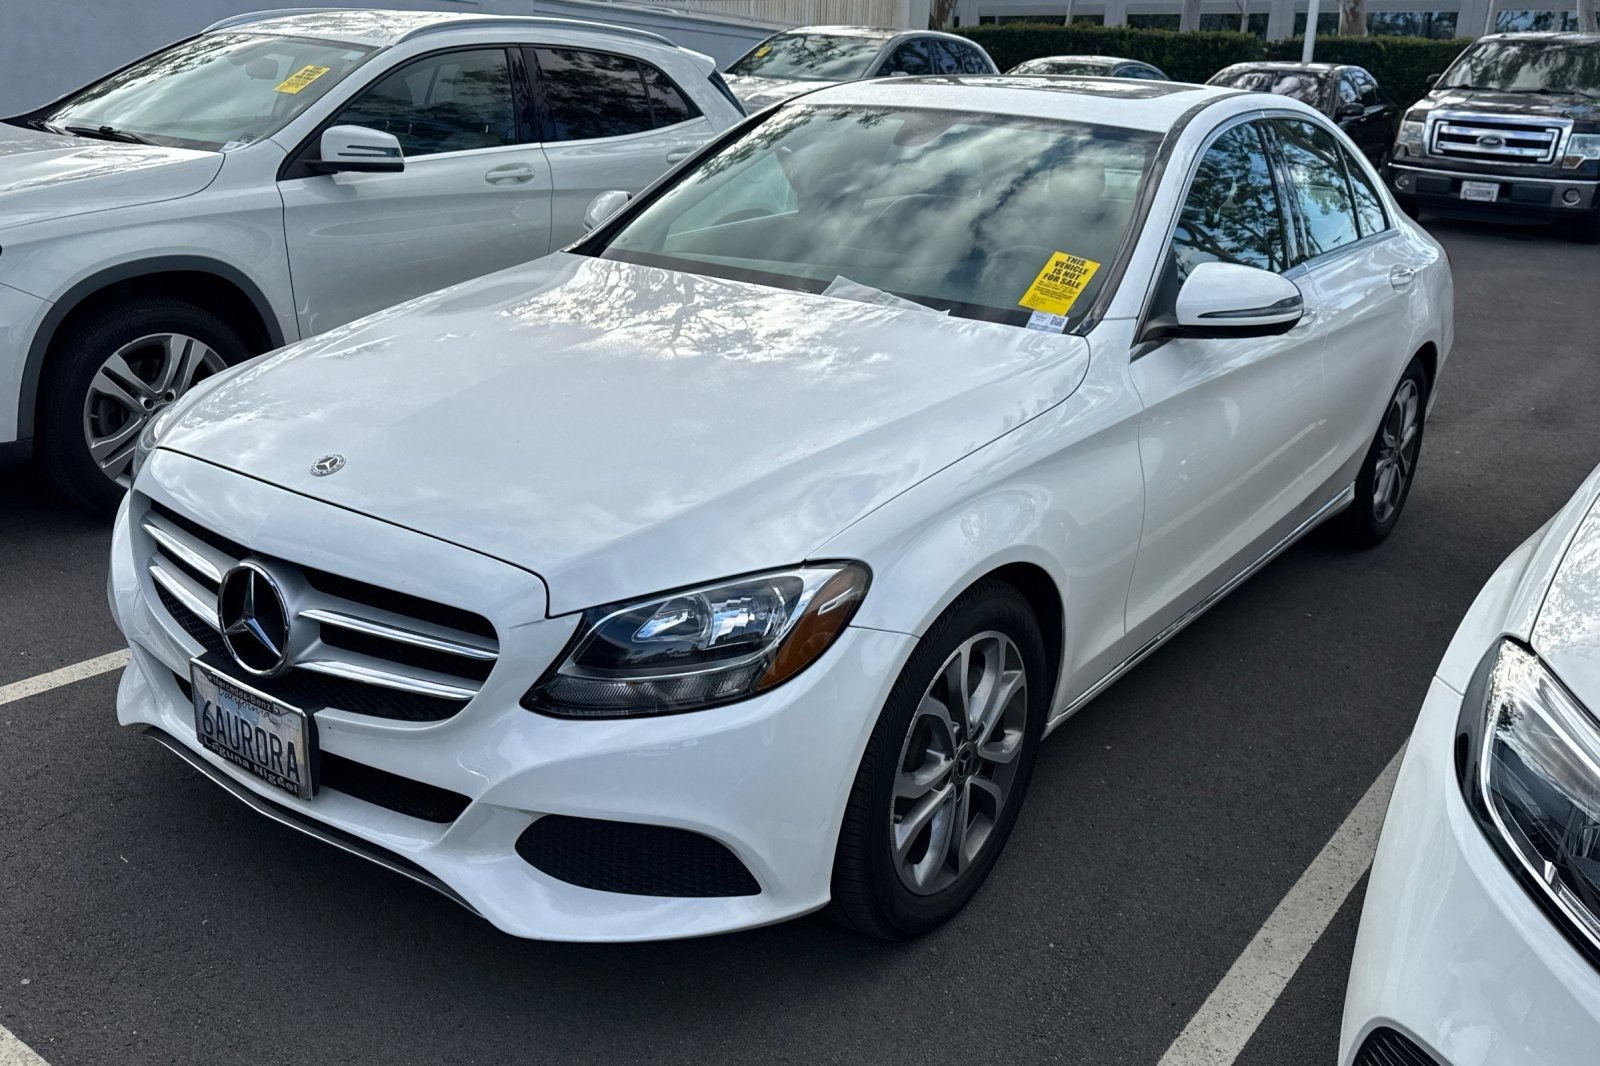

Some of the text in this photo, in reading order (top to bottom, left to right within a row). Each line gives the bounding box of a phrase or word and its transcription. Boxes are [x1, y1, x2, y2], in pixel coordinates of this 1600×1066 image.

[1055, 261, 1088, 274] VEHICLE
[1067, 256, 1086, 266] THIS
[1043, 273, 1060, 282] FOR
[1060, 278, 1082, 289] SALE
[1063, 271, 1081, 280] NOT
[203, 700, 300, 783] 6AURORA
[203, 735, 250, 768] Laguna
